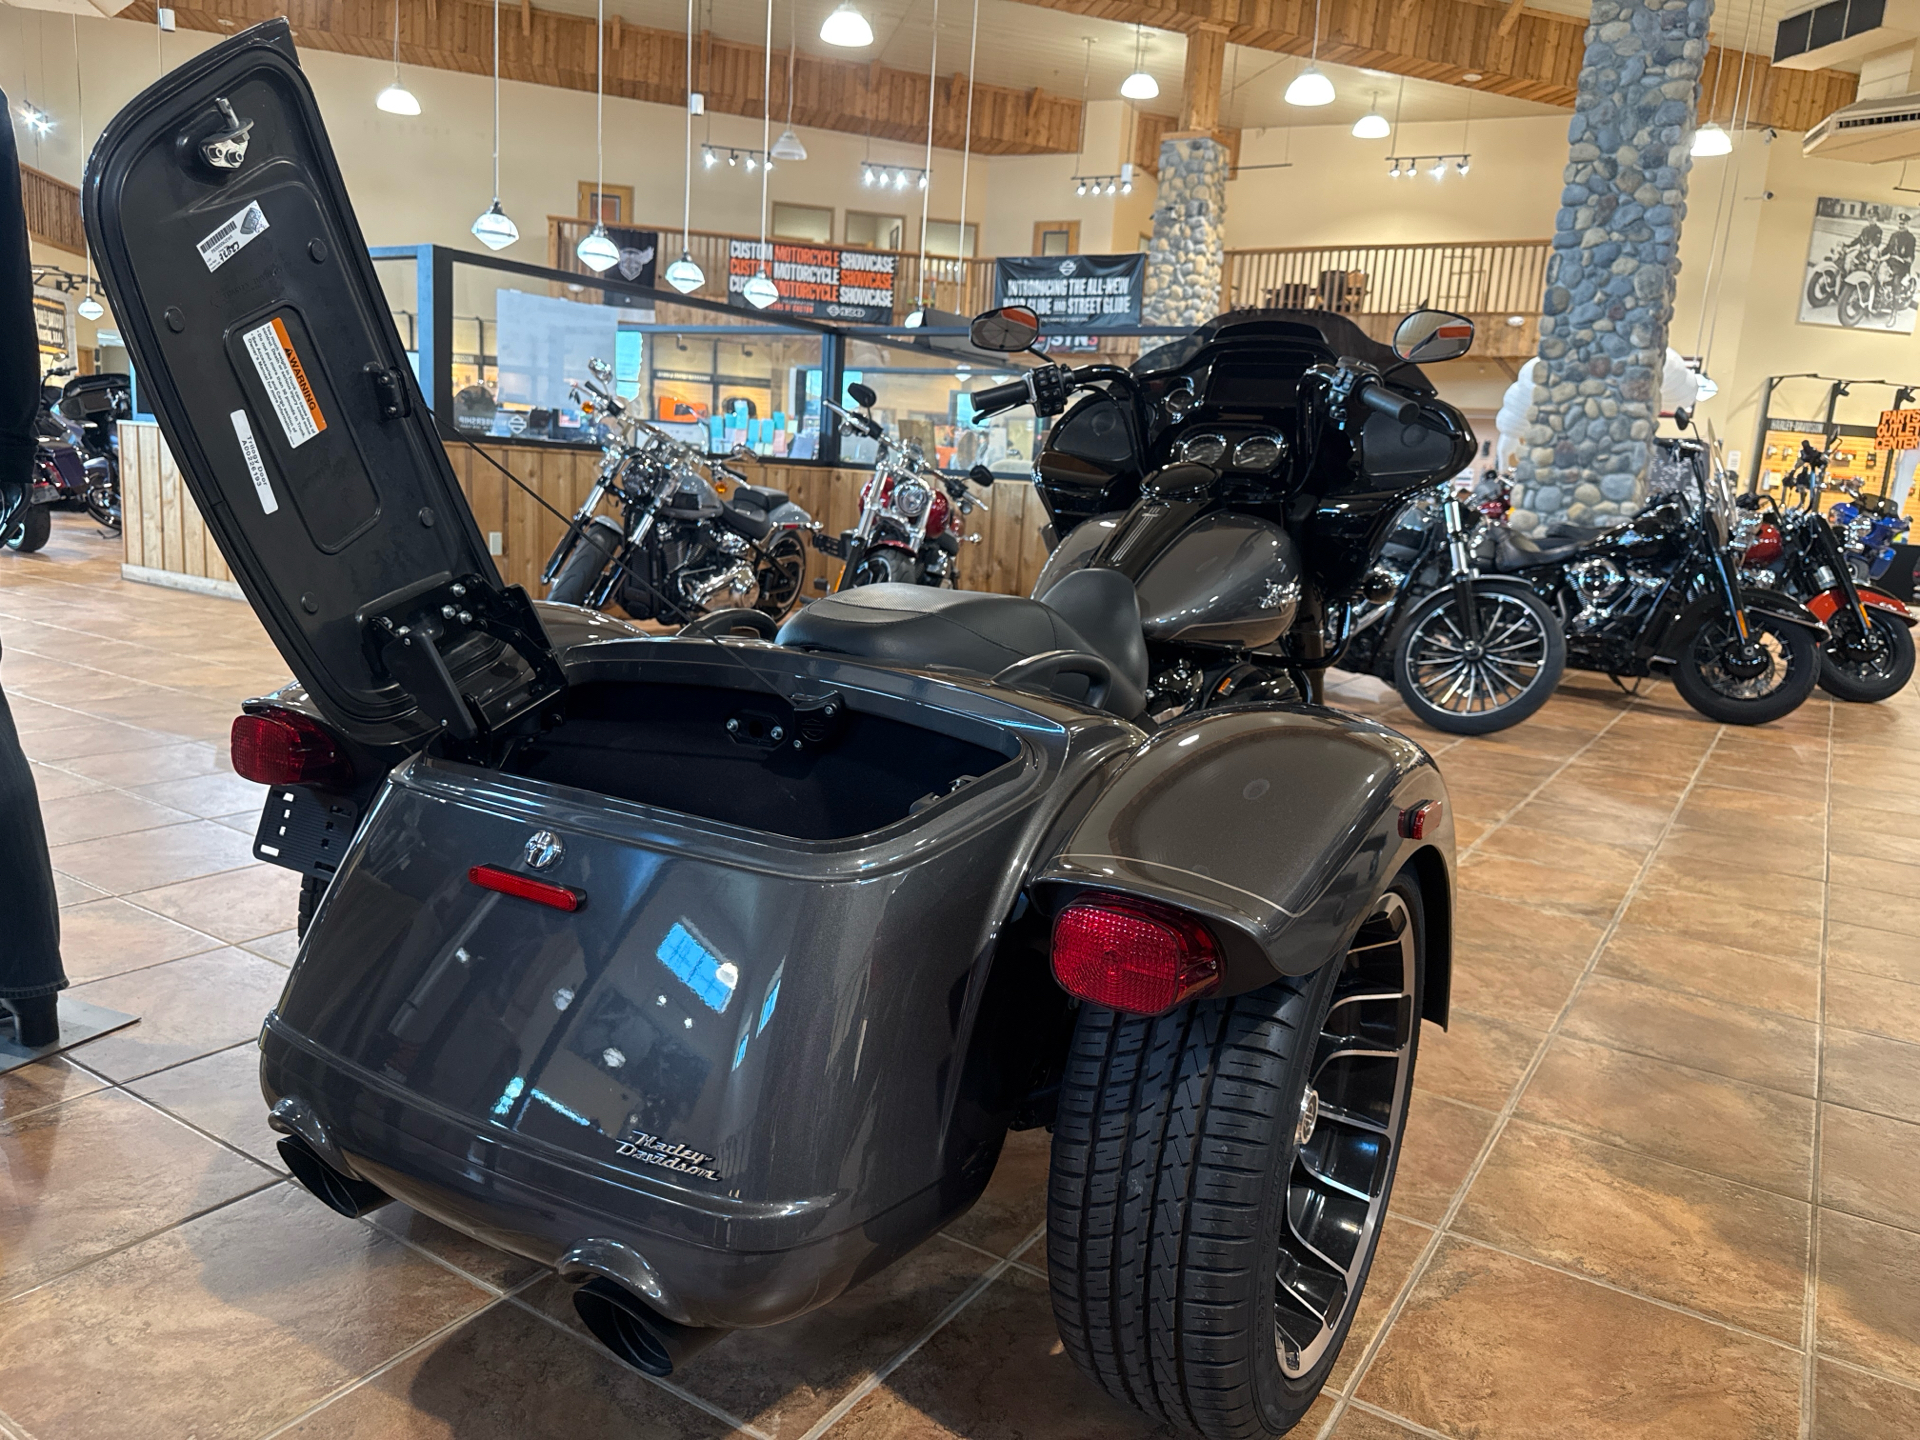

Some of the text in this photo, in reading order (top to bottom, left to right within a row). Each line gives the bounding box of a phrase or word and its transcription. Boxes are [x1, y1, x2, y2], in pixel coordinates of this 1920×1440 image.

[774, 244, 840, 269] MOTORCYCLE
[841, 252, 895, 273] SHOWCASE
[730, 257, 893, 290] CUSTM MOTORCYCLE SHOWCASE
[1008, 277, 1130, 296] INTRODUCING THE ALL-NEW
[773, 279, 839, 302] MOTORCYCLE
[840, 285, 893, 308] SHOWCASE
[1067, 297, 1102, 314] STREET
[1103, 296, 1131, 313] GLIDE
[290, 358, 317, 411] WARNING
[1877, 423, 1920, 437] OUTLET
[1881, 410, 1920, 424] PARTS
[1875, 437, 1919, 450] CENTER
[246, 435, 268, 486] Trilogy Door
[615, 1138, 720, 1181] Davidson
